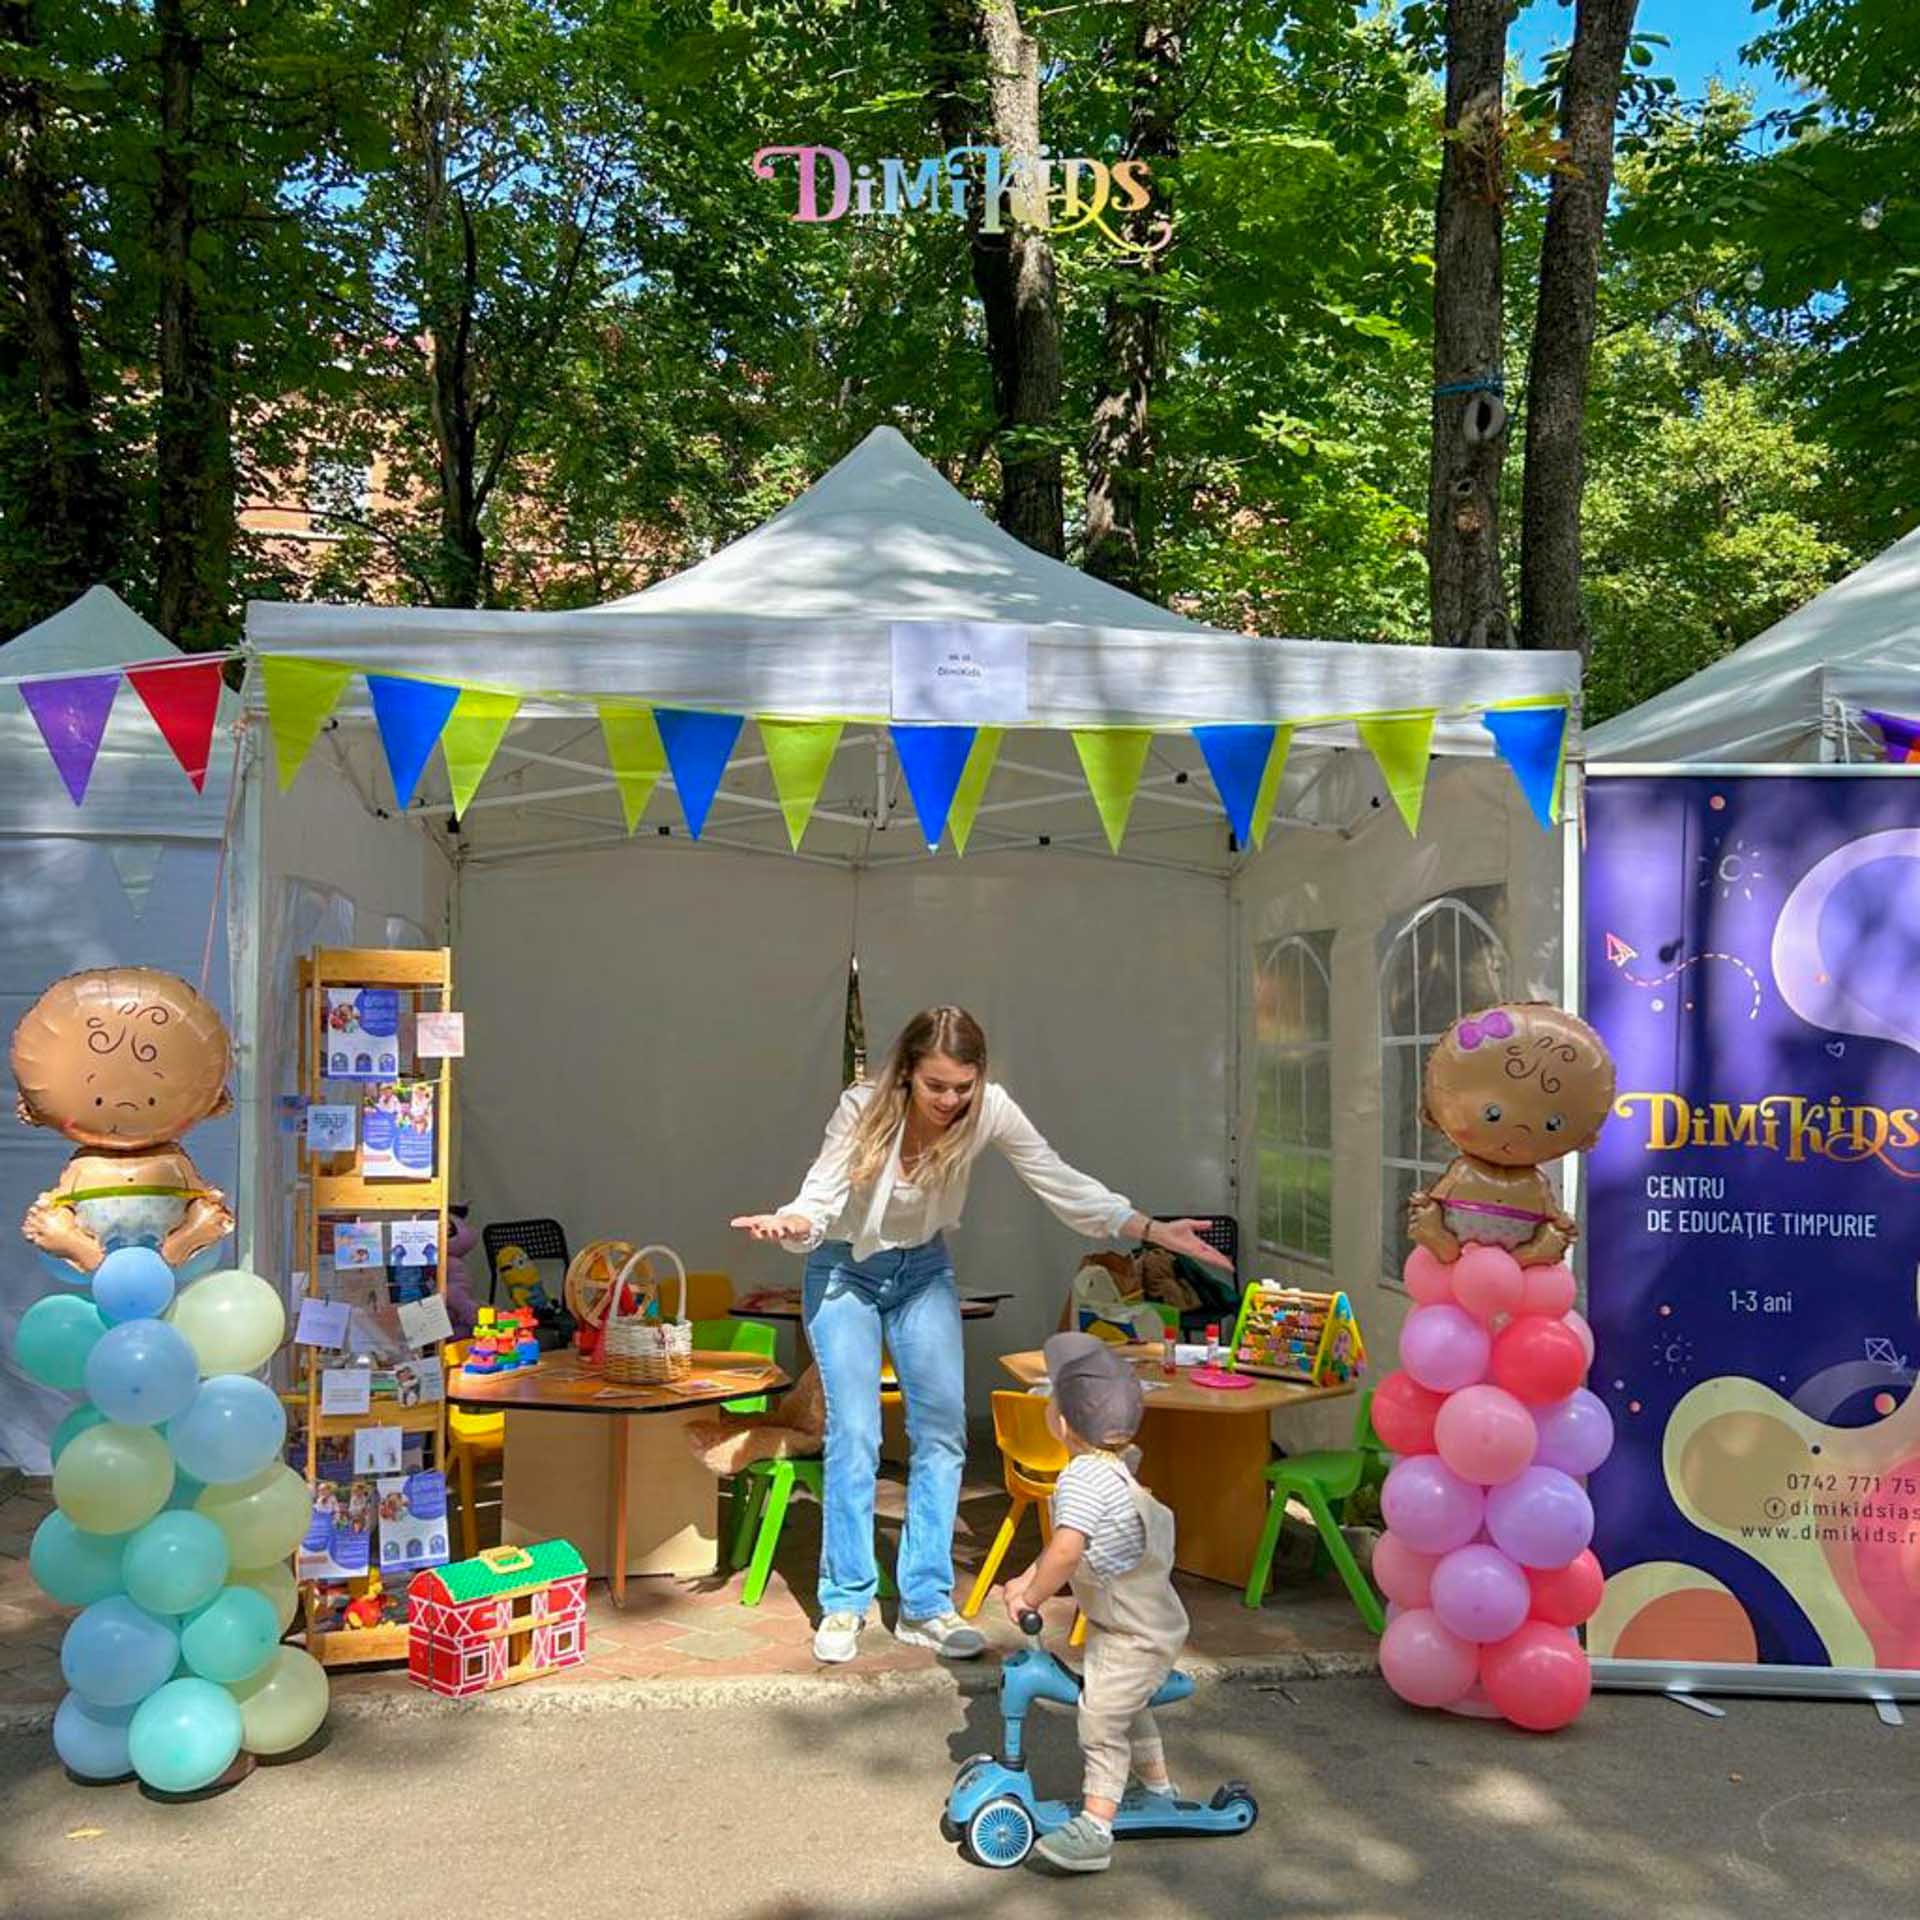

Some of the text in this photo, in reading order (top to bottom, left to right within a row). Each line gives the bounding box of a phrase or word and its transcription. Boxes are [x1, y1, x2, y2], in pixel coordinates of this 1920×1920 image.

[1646, 1175, 1725, 1199] CENTRU
[1646, 1209, 1672, 1233] DE
[1781, 1212, 1877, 1238] TIMPURIE
[1729, 1289, 1793, 1313] 1-3 ani
[1786, 1473, 1837, 1492] 0742
[1848, 1476, 1881, 1494] 771
